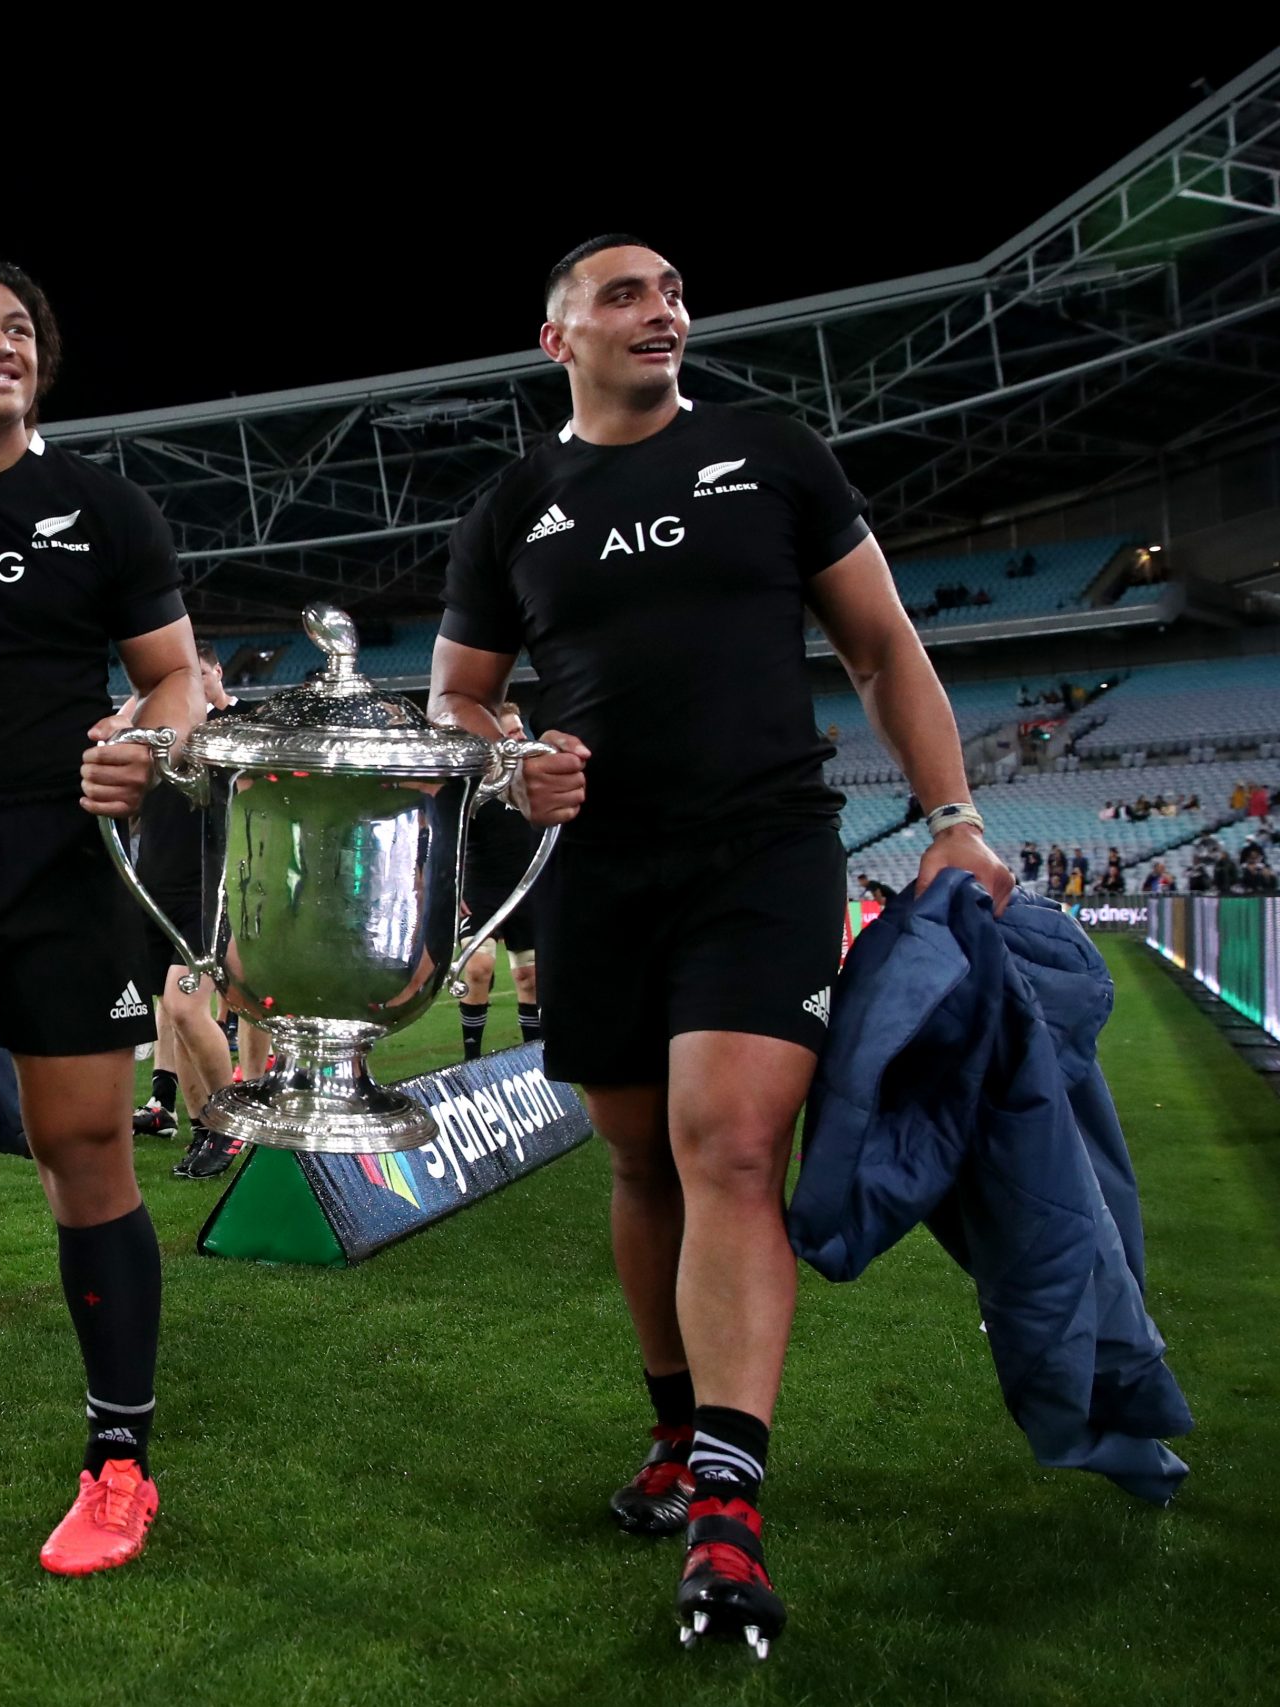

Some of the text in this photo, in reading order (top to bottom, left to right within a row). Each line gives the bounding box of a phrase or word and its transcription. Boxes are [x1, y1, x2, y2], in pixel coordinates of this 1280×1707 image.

[693, 482, 759, 498] ALL BLACKS
[526, 518, 575, 543] adidas
[599, 515, 685, 560] AIG
[31, 540, 91, 552] ALL BLACKS
[110, 1003, 148, 1019] adidas
